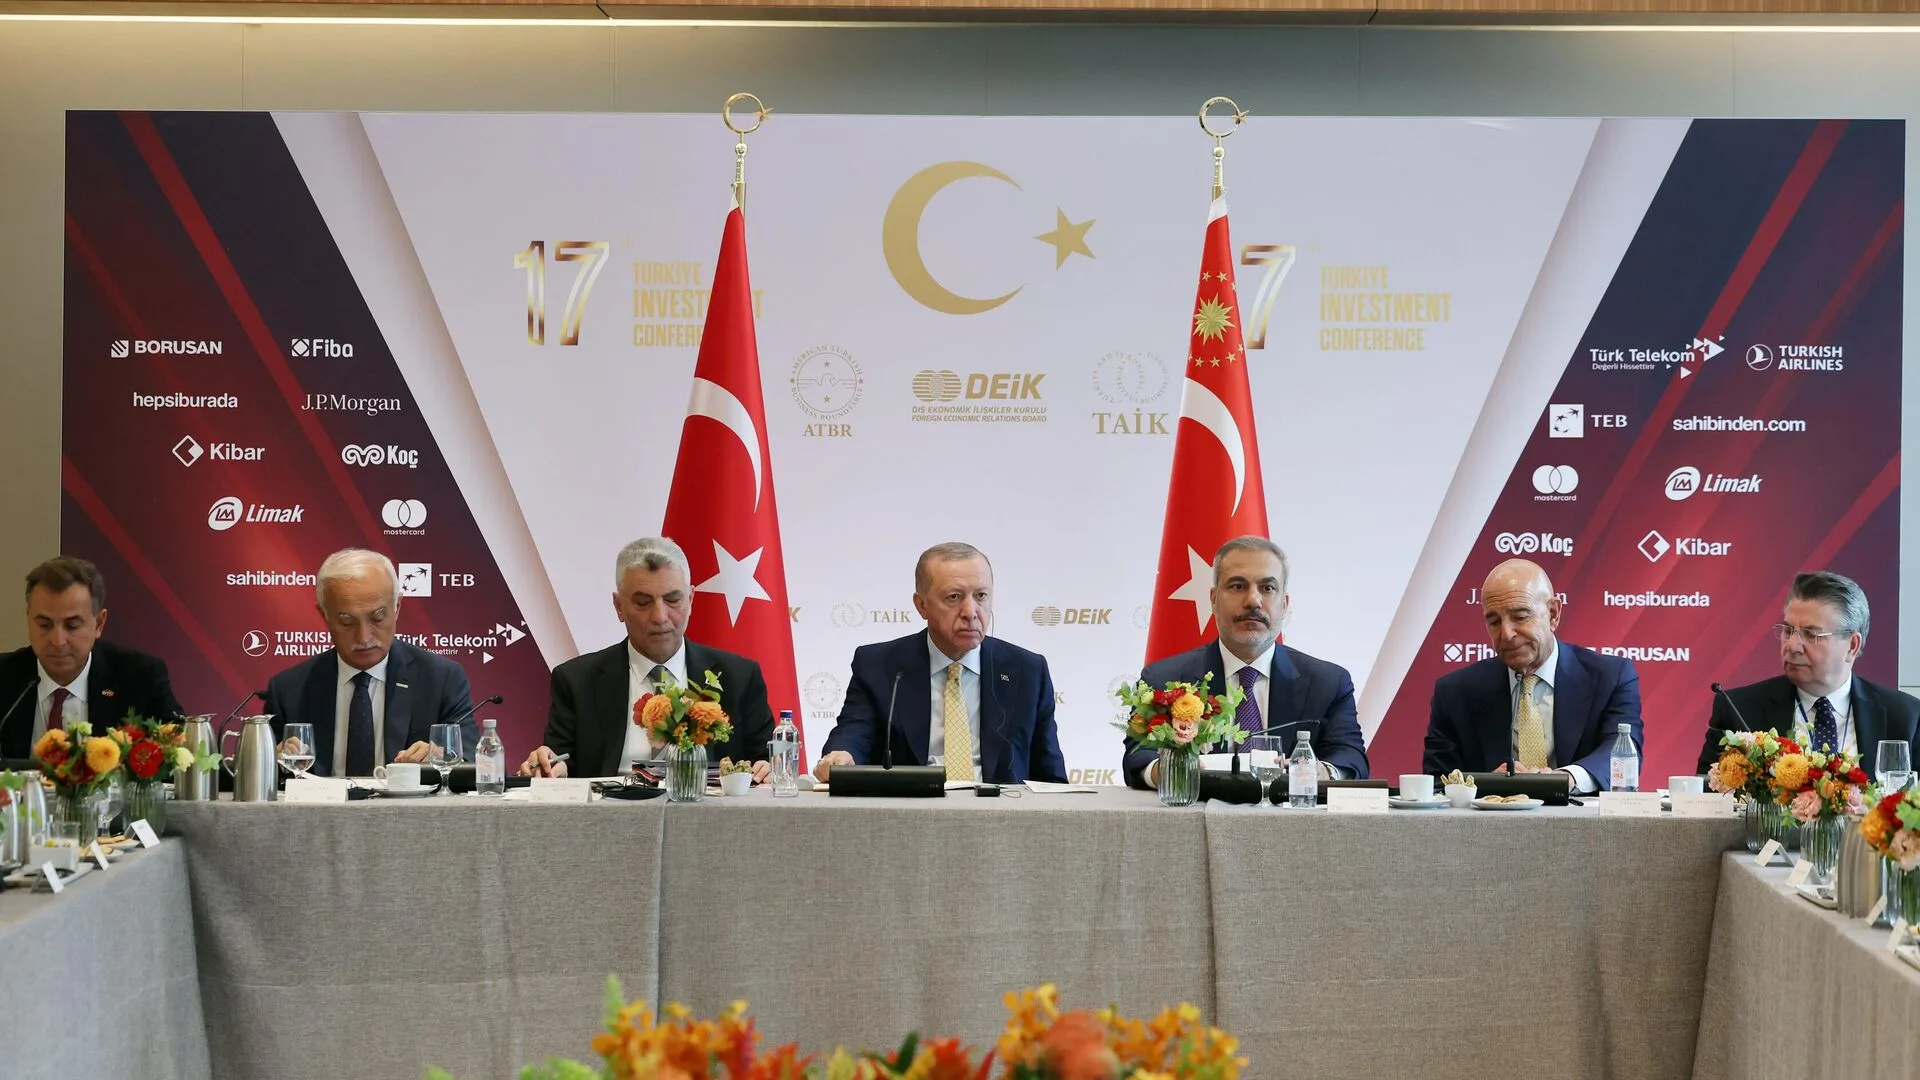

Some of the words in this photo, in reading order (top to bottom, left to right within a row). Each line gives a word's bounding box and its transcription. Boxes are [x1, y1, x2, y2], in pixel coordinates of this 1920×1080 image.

[514, 240, 610, 346] 17
[633, 289, 764, 318] INVESTT
[1320, 293, 1452, 322] INVESTMENT
[135, 340, 222, 354] BORUSAN
[313, 339, 353, 357] Fiba
[1320, 328, 1426, 350] CONFERENCE
[1590, 349, 1624, 362] Türk
[1629, 349, 1695, 362] Telekom
[1779, 346, 1843, 358] TURKISH
[1778, 359, 1844, 371] AIRLINES
[133, 392, 238, 411] hepsiburada
[301, 394, 401, 416] J.P.Morgan
[1022, 415, 1047, 423] BOARD
[1092, 408, 1170, 435] TAİK
[1591, 415, 1627, 428] TEB
[1672, 416, 1806, 432] sahibinden.com
[803, 424, 853, 437] ATBR
[210, 443, 266, 461] Kibar
[388, 445, 418, 469] Koç
[1703, 474, 1763, 493] Limak
[1534, 494, 1577, 502] mastercard
[246, 504, 304, 522] Limak
[384, 528, 425, 536] mastercard
[1541, 533, 1573, 556] Koç
[1675, 538, 1732, 556] Kibar
[439, 574, 475, 587] TEB
[1604, 591, 1710, 610] hepsiburada
[870, 608, 911, 623] TAİK
[433, 633, 497, 647] Telekom
[274, 644, 335, 656] AIRLINE
[1465, 643, 1498, 663] Fib
